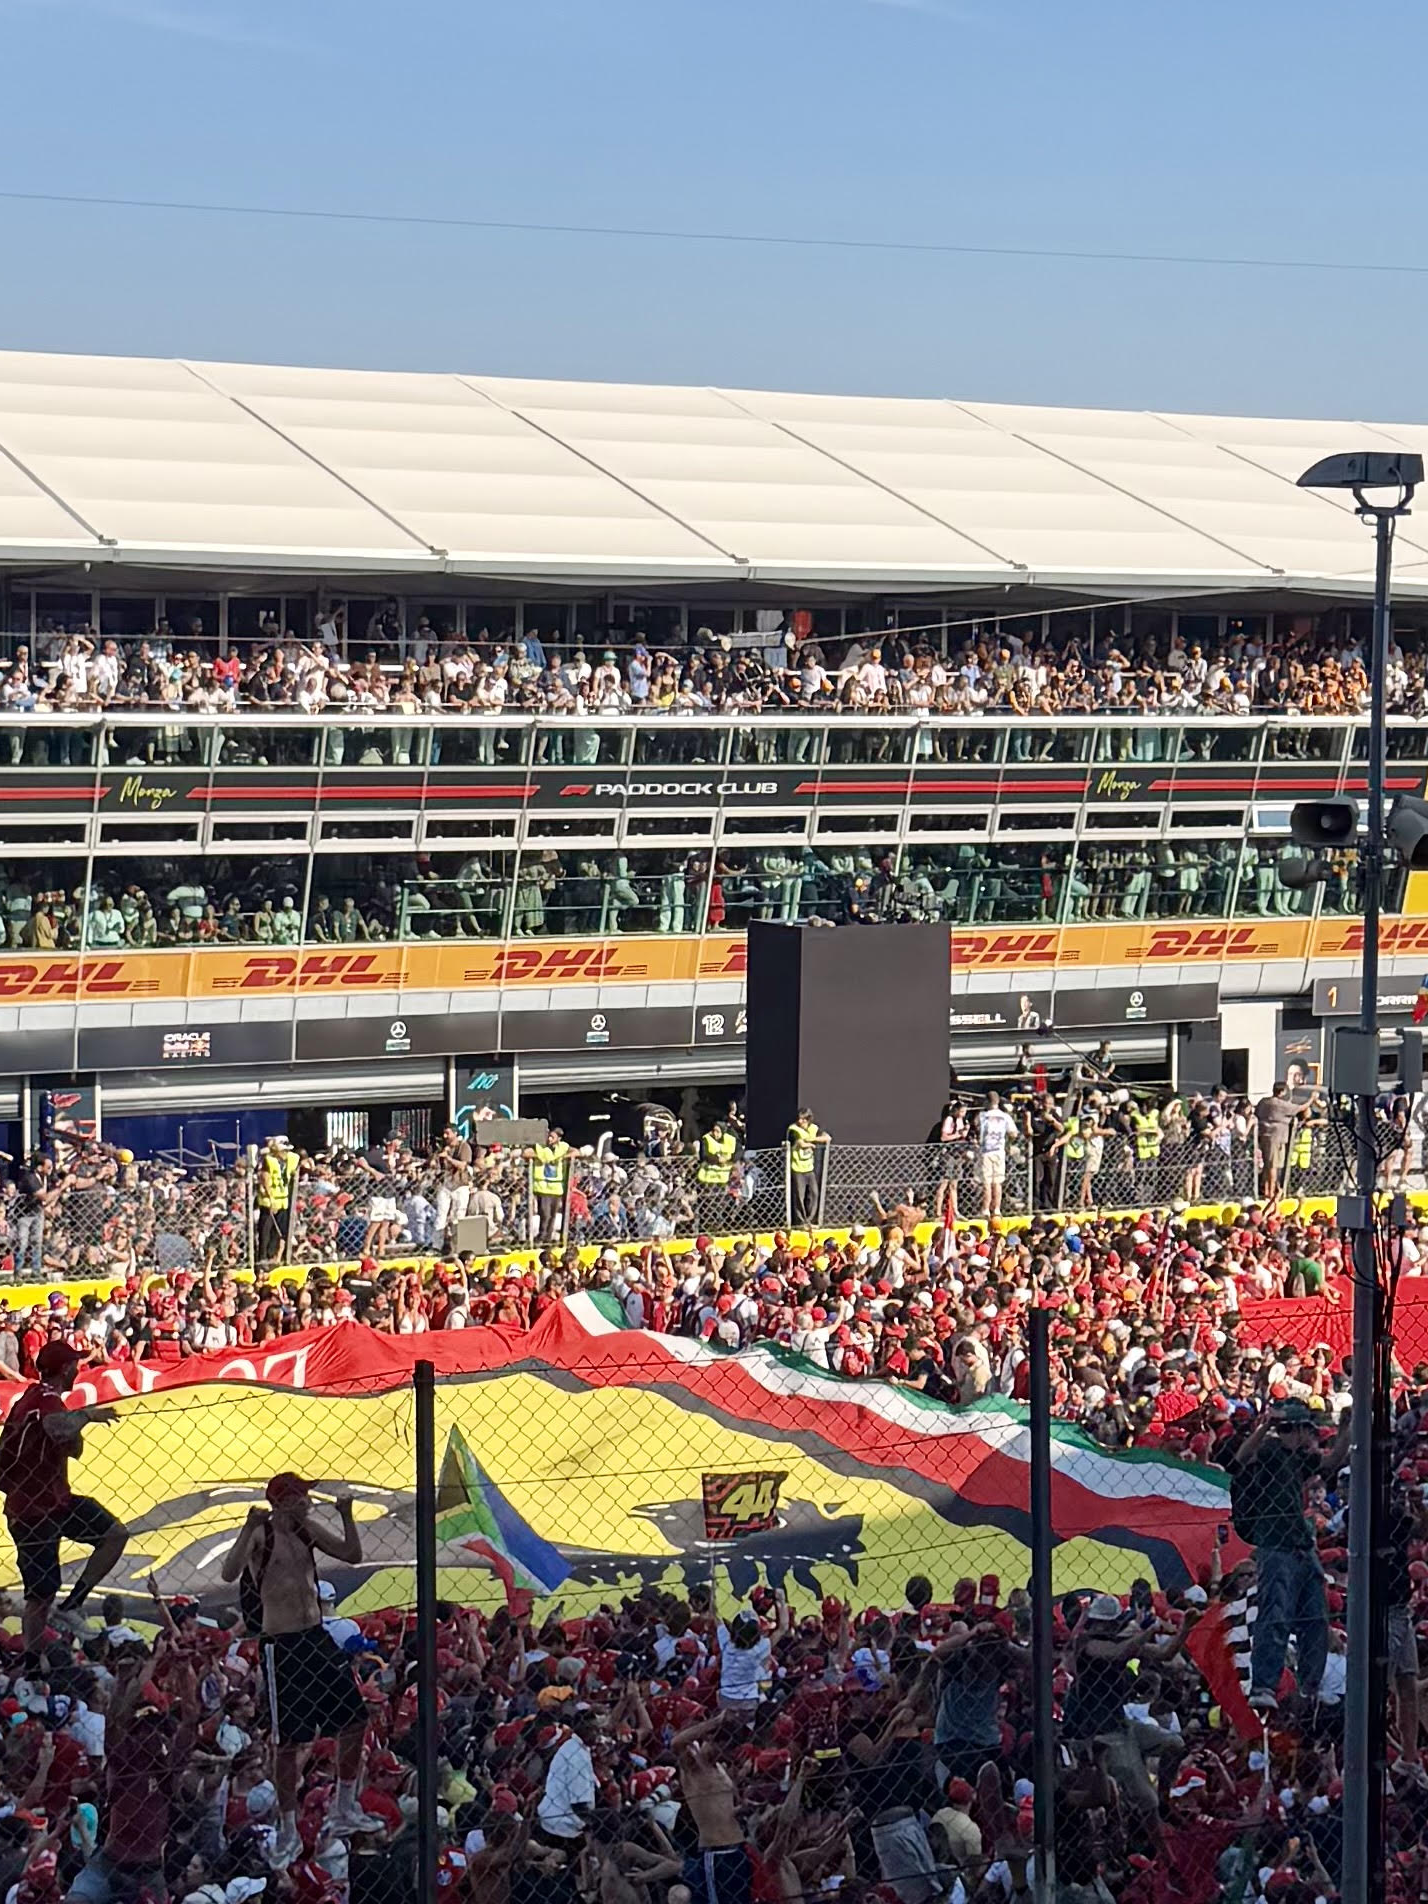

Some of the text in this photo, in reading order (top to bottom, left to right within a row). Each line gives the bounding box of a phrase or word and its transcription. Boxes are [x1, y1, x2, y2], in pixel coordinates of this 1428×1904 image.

[119, 775, 178, 810] Monza
[594, 783, 713, 796] PADDOCK
[716, 781, 778, 795] CLUB
[1096, 769, 1143, 801] Monza
[1146, 927, 1259, 957] DHL
[239, 954, 383, 988] DHL
[489, 948, 623, 980] DHL
[1327, 986, 1338, 1007] 1
[163, 1031, 211, 1043] ORACLE
[701, 1014, 725, 1035] 12
[719, 1480, 775, 1522] 44
